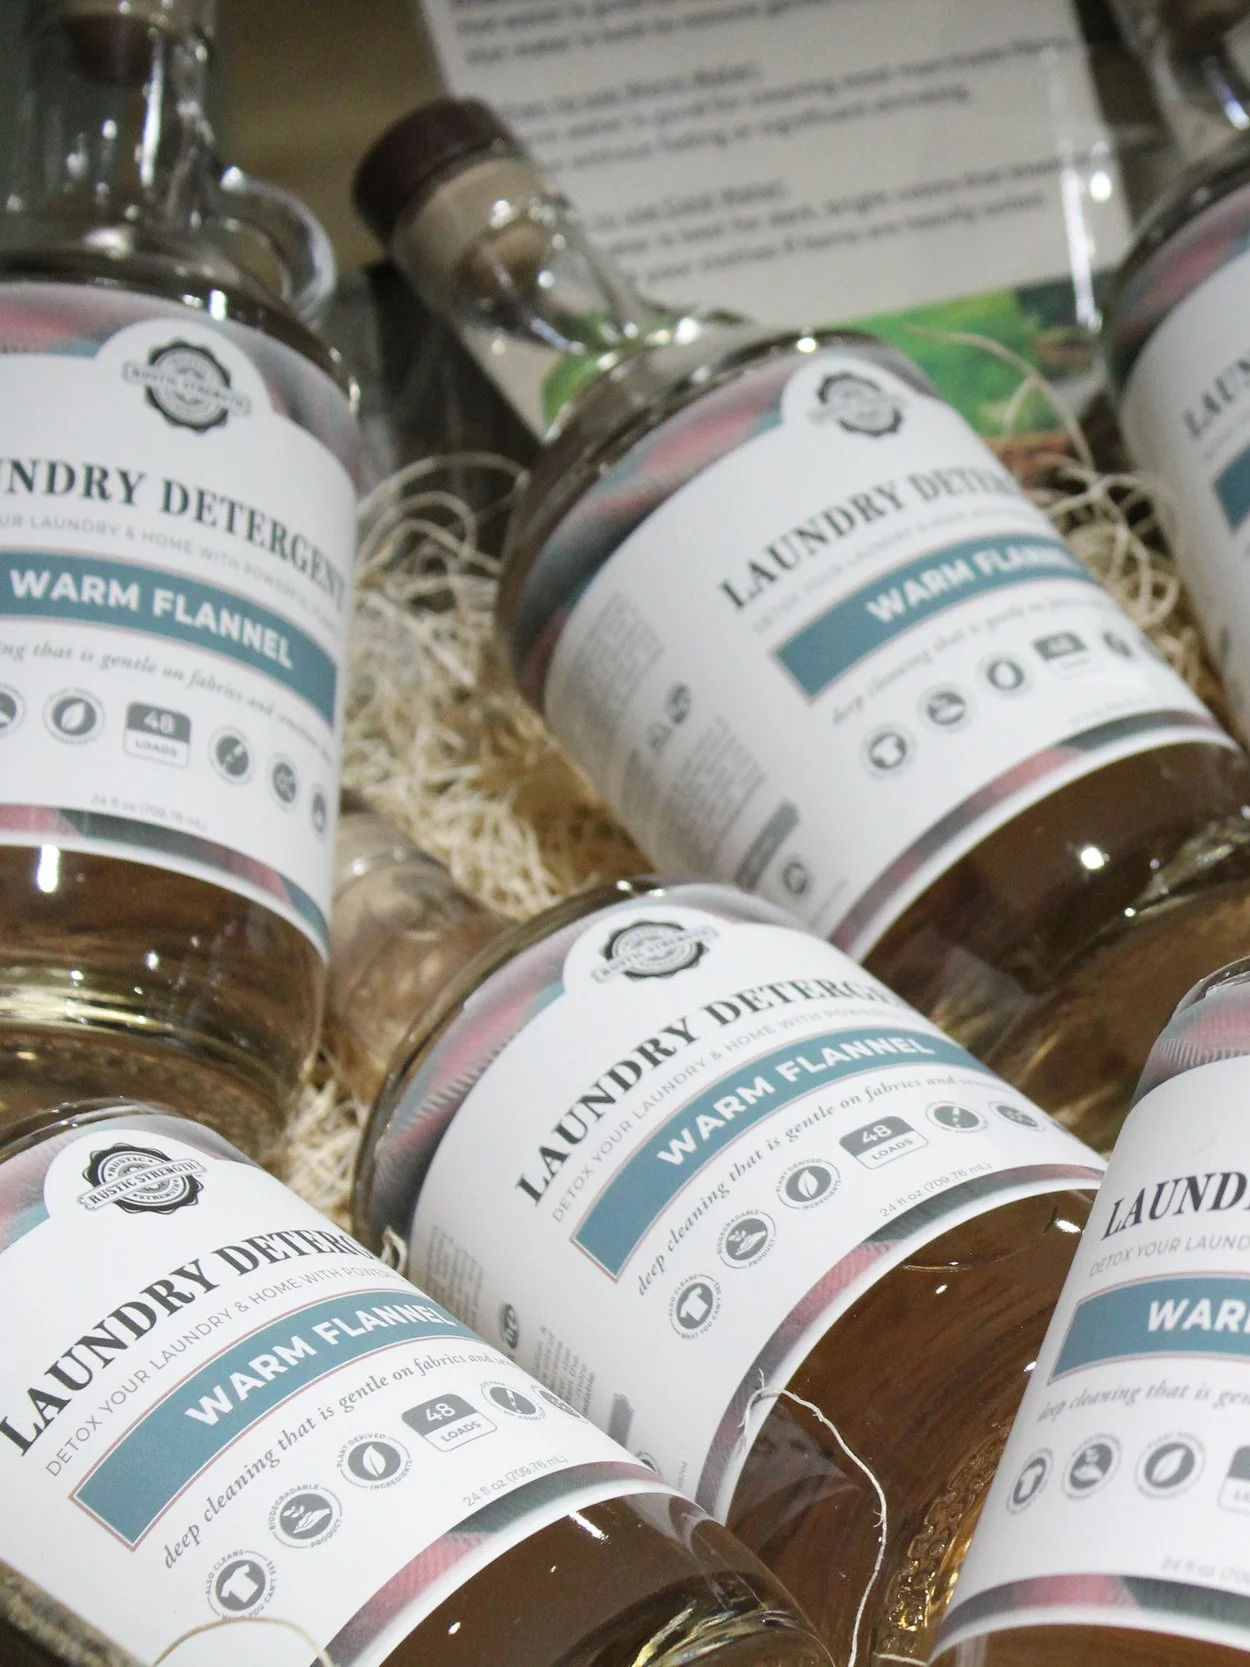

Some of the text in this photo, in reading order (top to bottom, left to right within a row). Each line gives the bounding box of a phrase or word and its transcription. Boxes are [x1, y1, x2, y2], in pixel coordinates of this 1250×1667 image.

[0, 457, 146, 506] NDRY
[717, 479, 906, 612] LAUNDRY
[864, 558, 977, 624] WARM
[9, 569, 140, 612] WARM
[152, 589, 294, 670] FLANNEL
[142, 708, 176, 735] 48
[514, 978, 890, 1208] LAUNDRY DETERG
[656, 1036, 937, 1166] WARM FLANNEL
[552, 1165, 594, 1223] DETOX
[592, 1120, 634, 1165] YOUR
[635, 1058, 707, 1121] LAUNDRY
[711, 1048, 724, 1062] &
[724, 1024, 775, 1053] HOME
[860, 1123, 893, 1146] 48
[870, 1137, 915, 1162] LOADS
[88, 1160, 199, 1205] RUSTIC STRENGTH
[638, 1251, 666, 1297] deep
[667, 1180, 731, 1253] cleaning
[728, 1150, 763, 1182] that
[768, 1135, 782, 1152] is
[785, 1102, 836, 1143] gentle
[839, 1092, 862, 1109] on
[864, 1077, 923, 1105] fabrics
[878, 1203, 897, 1218] 24
[907, 1187, 925, 1203] oz
[1089, 1247, 1132, 1278] DETOX
[1136, 1237, 1181, 1258] YOUR
[0, 1229, 376, 1457] LAUNDRY DETERG
[184, 1303, 458, 1427] WARM FLANNEL
[46, 1266, 343, 1478] DETOX YOUR LAUNDRY & HOME WITH
[1067, 1384, 1141, 1412] cleaning
[1146, 1378, 1189, 1400] that
[1194, 1381, 1211, 1401] is
[424, 1402, 457, 1423] 48
[440, 1421, 482, 1443] LOADS
[163, 1523, 201, 1570] deep
[202, 1451, 281, 1524] cleaning
[277, 1418, 317, 1452] that
[318, 1405, 336, 1422] is
[338, 1375, 390, 1413] gentle
[392, 1364, 415, 1383] on
[413, 1353, 467, 1378] fabrics
[336, 1432, 387, 1468] PLANT DERIVED
[369, 1459, 413, 1491] INGREDIENTS
[463, 1493, 480, 1507] 24
[479, 1485, 491, 1498] fl
[491, 1478, 507, 1493] oz
[505, 1458, 546, 1487] (709.76
[269, 1483, 320, 1531] BIODEGRADABLE
[309, 1517, 343, 1549] PRODUCT
[204, 1549, 244, 1595] ALSO CLEANS
